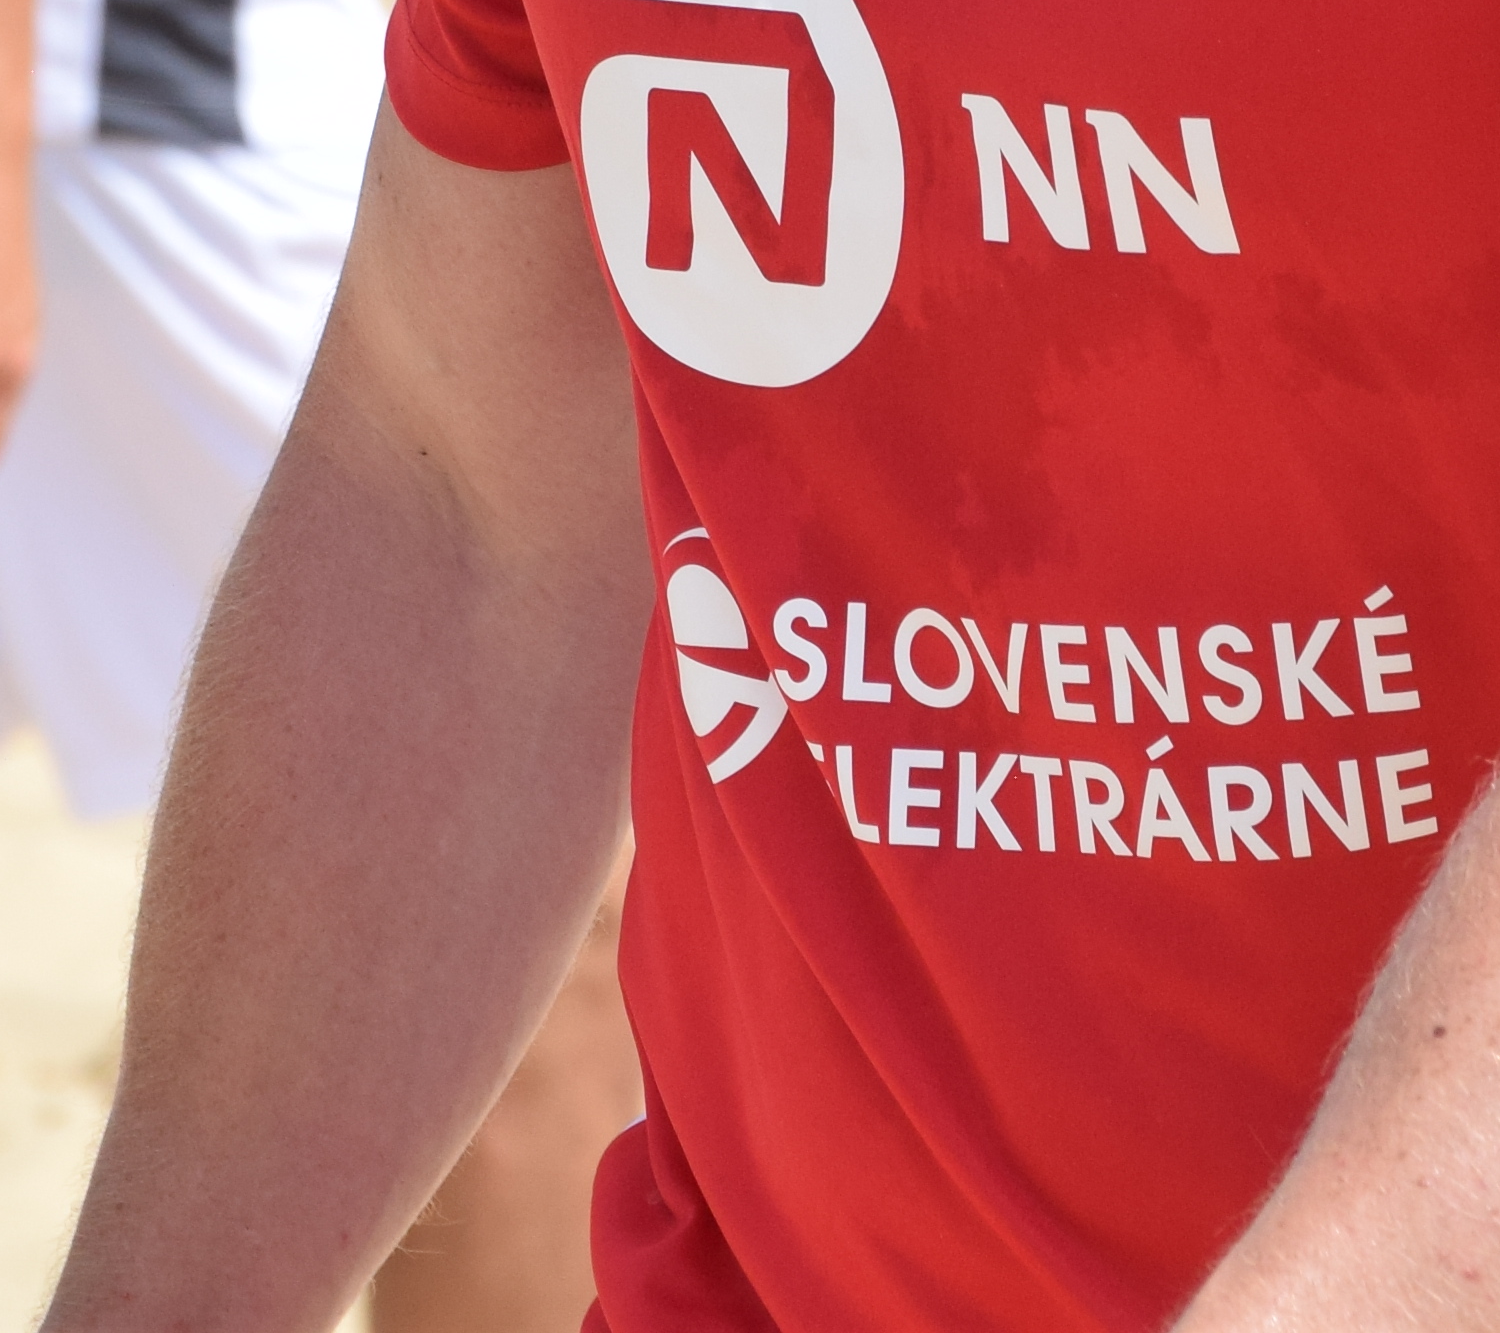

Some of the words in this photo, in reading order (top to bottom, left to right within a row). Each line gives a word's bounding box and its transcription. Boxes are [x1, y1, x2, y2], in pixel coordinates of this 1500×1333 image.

[961, 92, 1241, 255] NN
[772, 585, 1422, 726] SLOVENSKÉ
[808, 736, 1439, 863] LEKTRÁRNE
